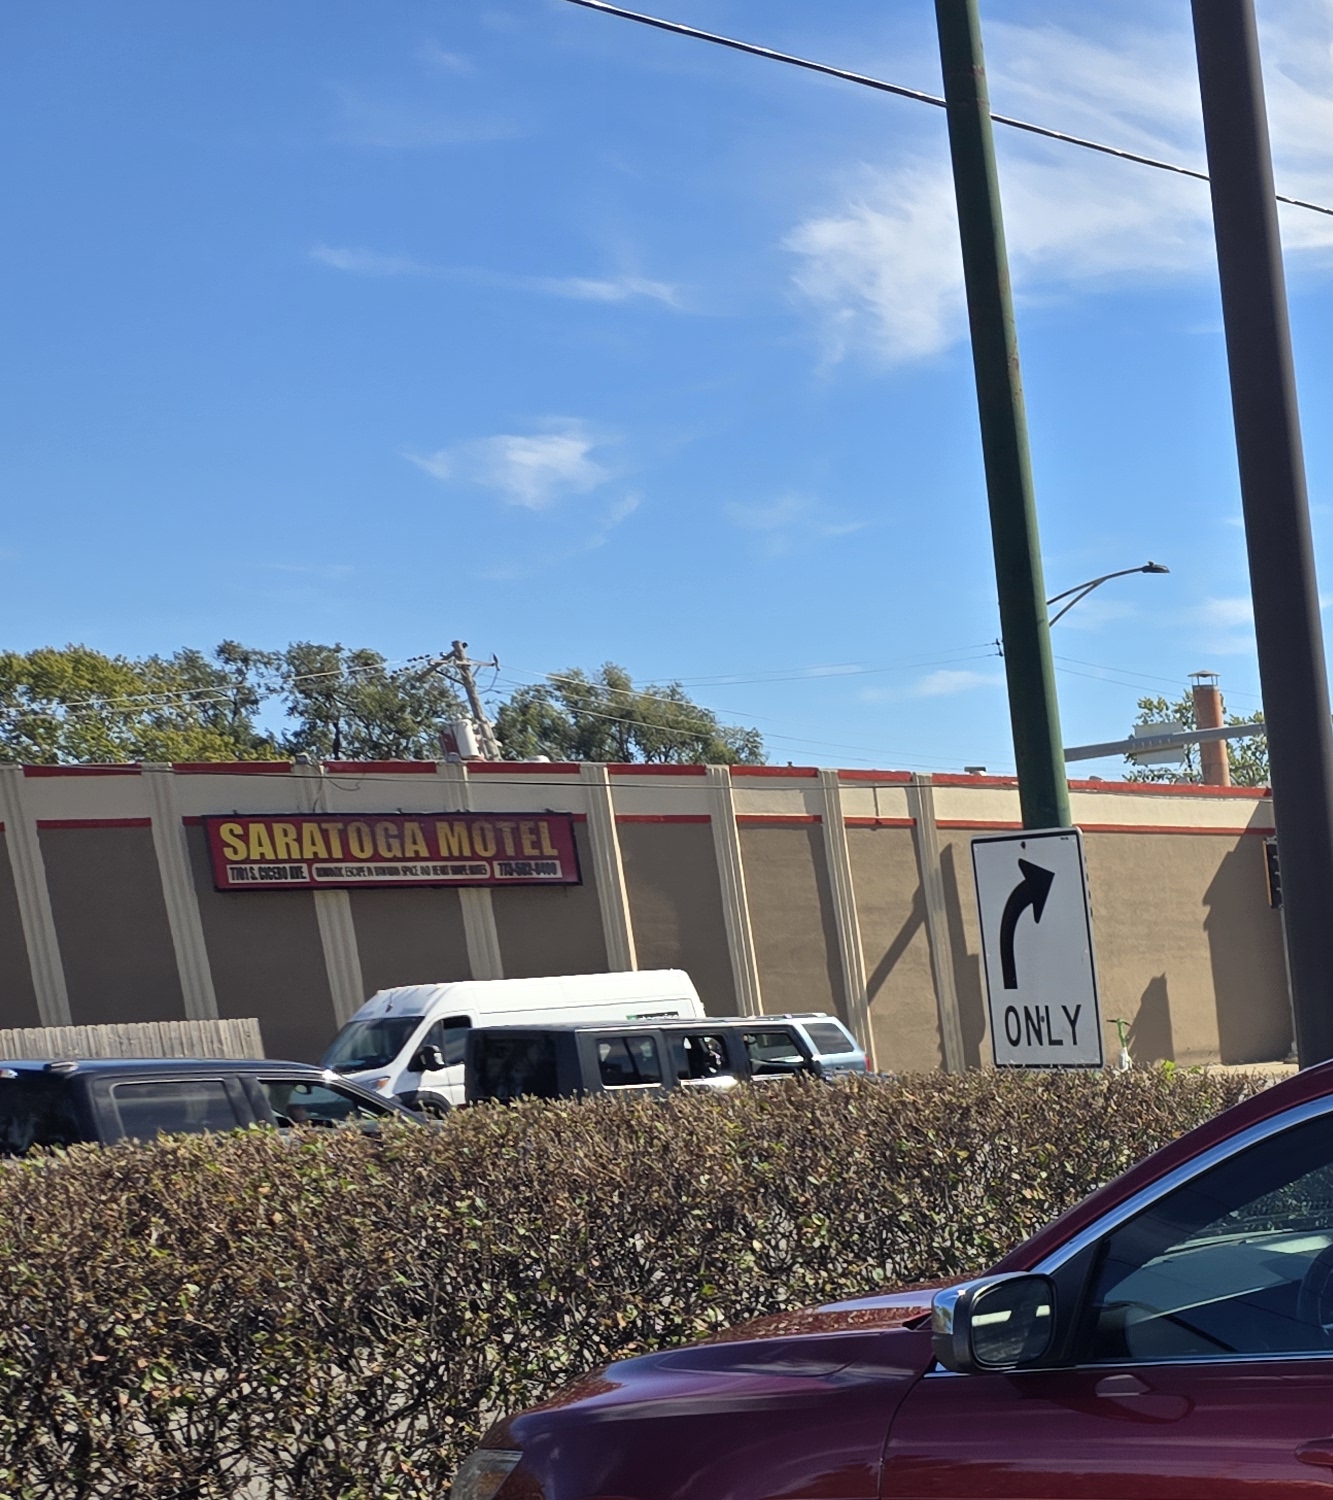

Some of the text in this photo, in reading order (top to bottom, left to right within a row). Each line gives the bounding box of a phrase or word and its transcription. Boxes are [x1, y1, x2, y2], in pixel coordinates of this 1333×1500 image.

[219, 820, 559, 861] SARATOGA MOTEL
[1004, 1004, 1081, 1046] ONLY
